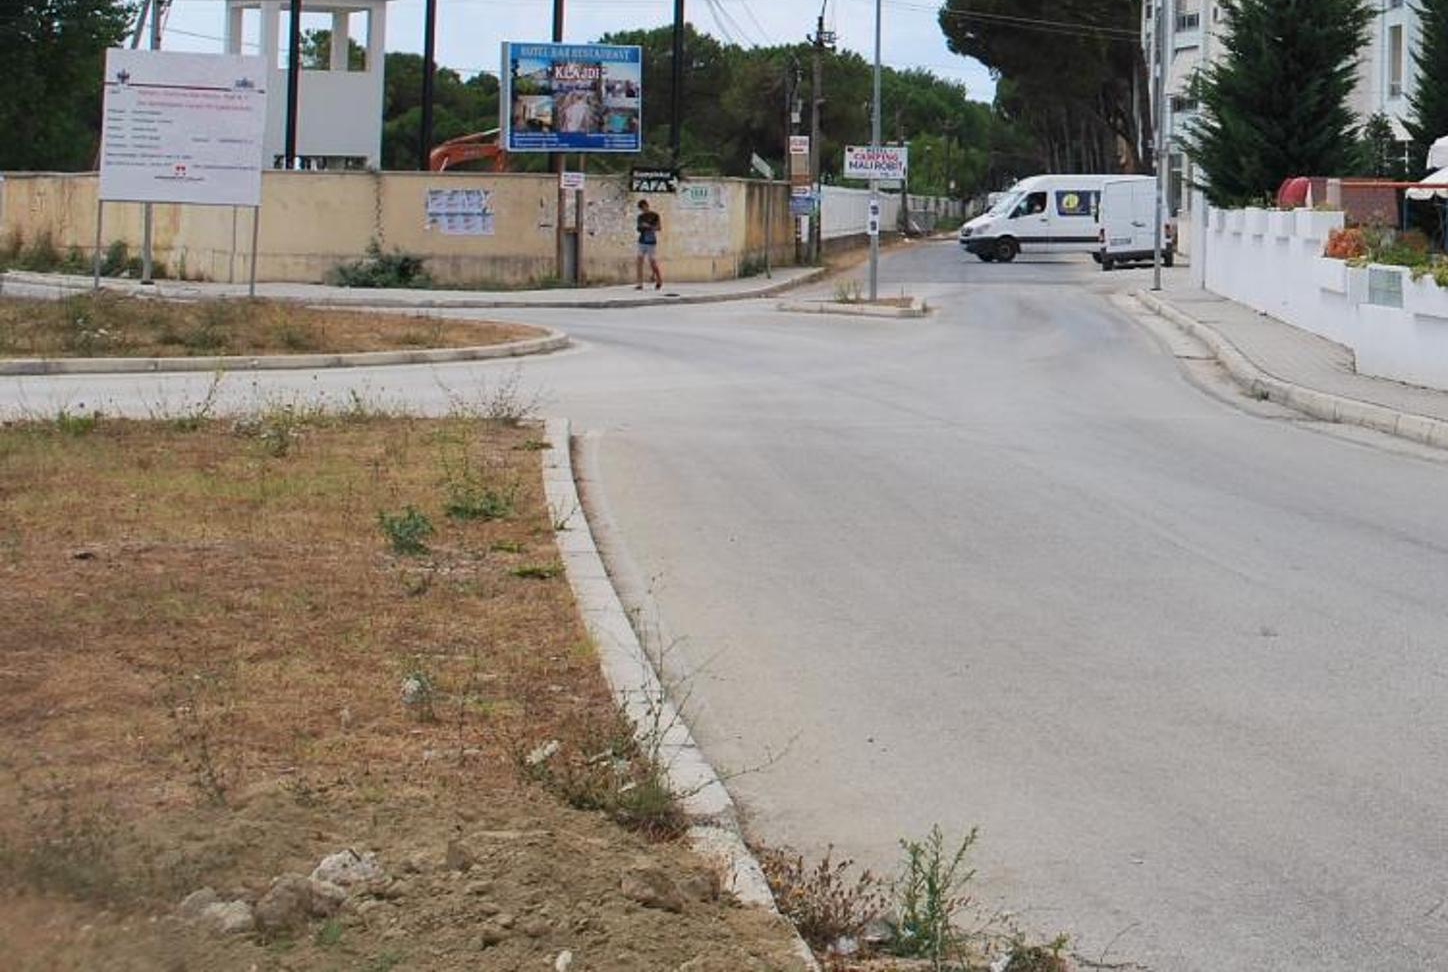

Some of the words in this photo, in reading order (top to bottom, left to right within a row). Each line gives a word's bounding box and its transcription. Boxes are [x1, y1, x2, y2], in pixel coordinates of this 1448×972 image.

[554, 65, 600, 79] KLAJDI
[855, 153, 897, 162] CAMPING
[632, 180, 668, 191] FAFA
